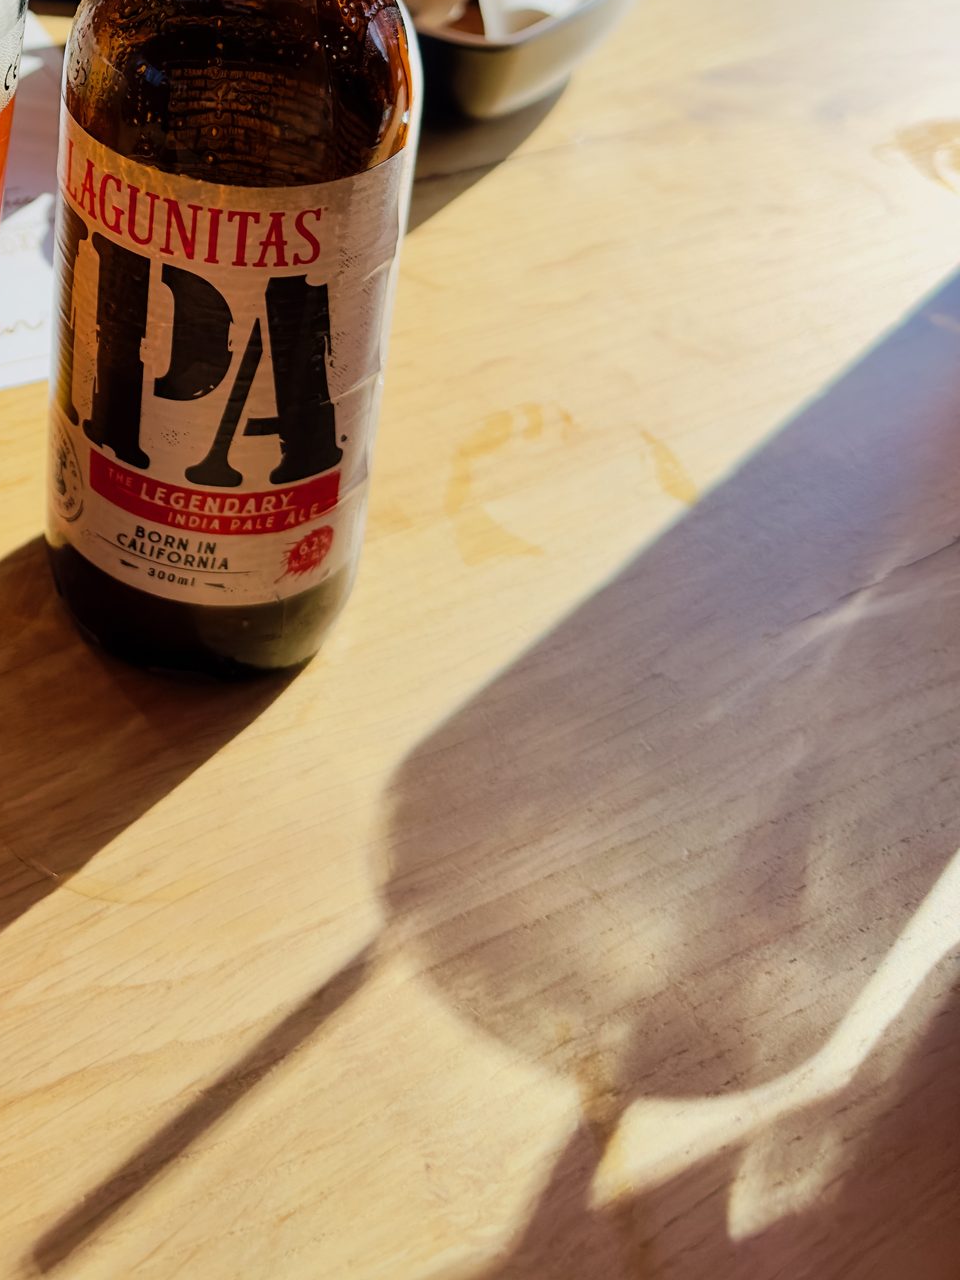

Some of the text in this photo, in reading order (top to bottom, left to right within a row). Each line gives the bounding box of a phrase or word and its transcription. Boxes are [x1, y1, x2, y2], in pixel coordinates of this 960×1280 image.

[65, 137, 323, 268] LAGUNITAS
[108, 467, 295, 514] THE LEGENDARY
[167, 503, 319, 531] INDIA PALE ALE
[116, 533, 229, 570] CALIFORNIA
[135, 524, 217, 555] BORN IN
[147, 567, 196, 587] 300ml
